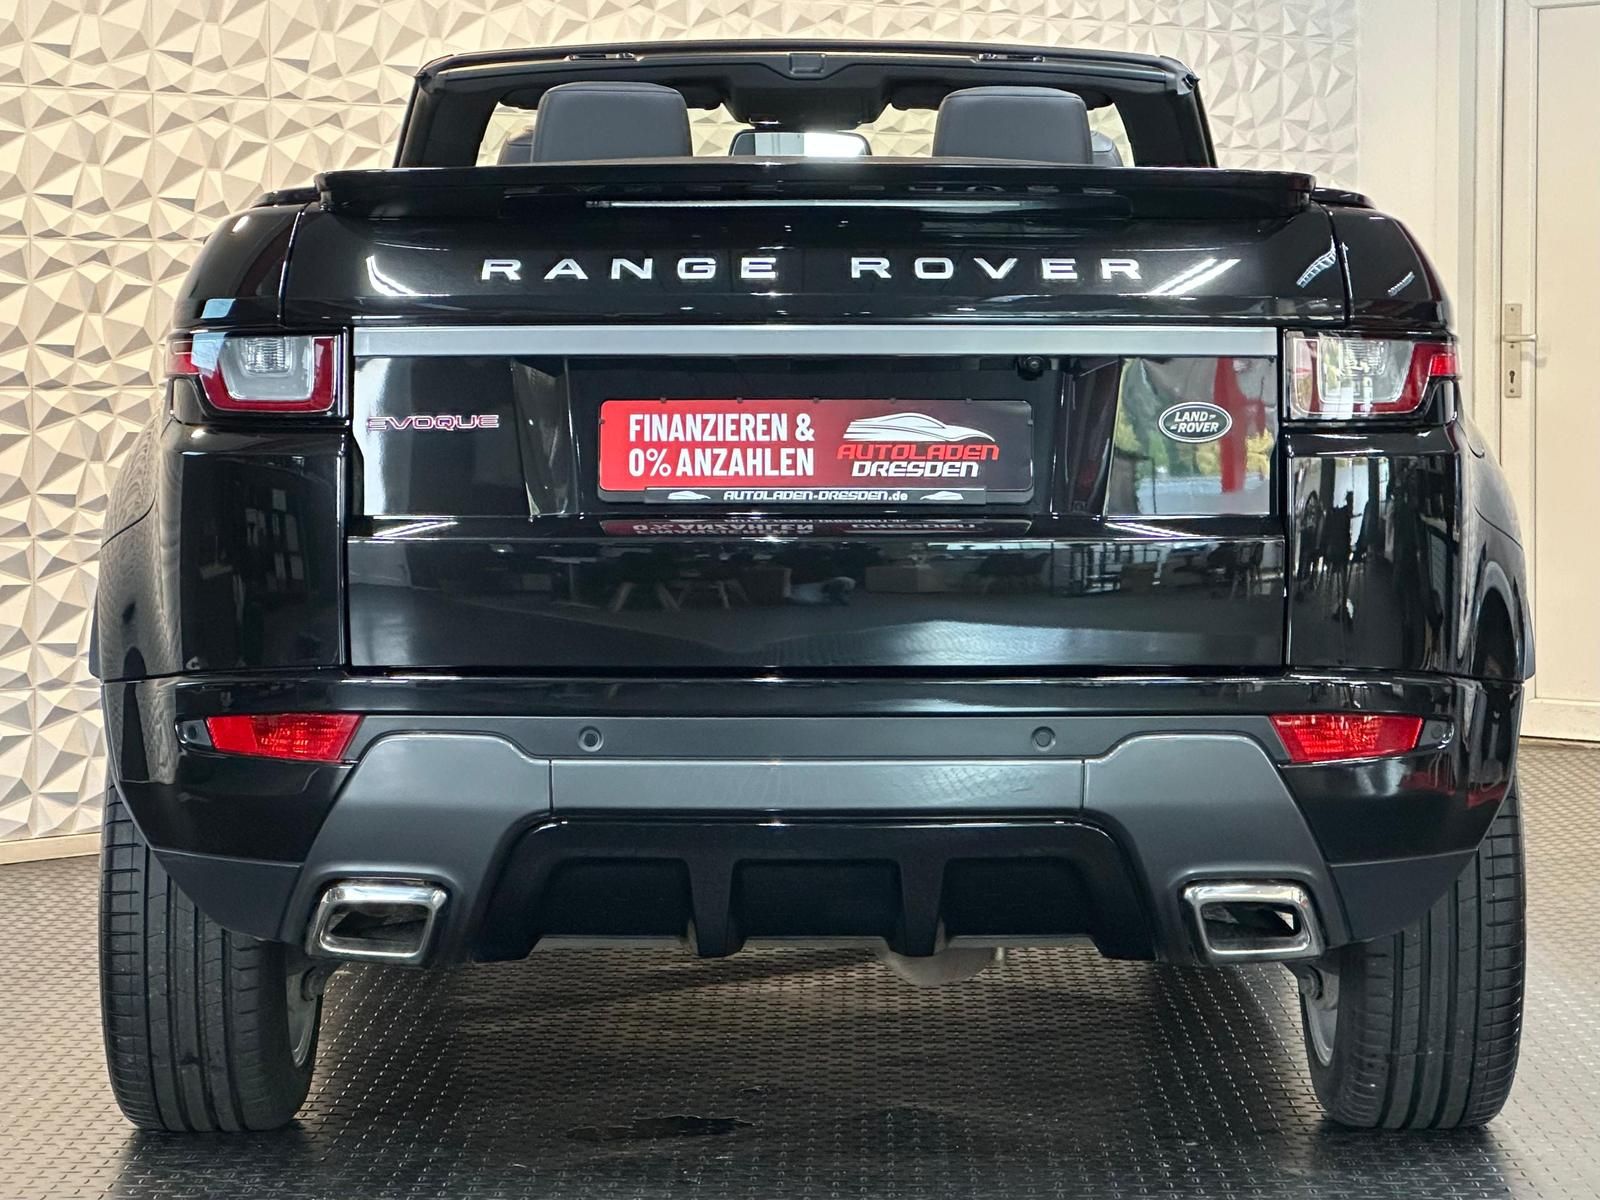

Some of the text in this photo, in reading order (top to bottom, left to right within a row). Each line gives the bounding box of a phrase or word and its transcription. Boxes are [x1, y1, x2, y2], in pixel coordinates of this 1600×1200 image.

[481, 257, 1142, 280] RANGE ROVER
[367, 415, 499, 431] EVOQUE
[1174, 411, 1208, 422] LAND
[629, 413, 815, 442] FINANZIEREN &
[1177, 422, 1219, 433] ROVER
[837, 444, 1000, 460] AUTOLADEN
[629, 448, 815, 477] 0% ANZAHLEN
[852, 461, 979, 477] DRESDEN
[723, 490, 908, 501] AUTOLADEN-DRESDEN.de
